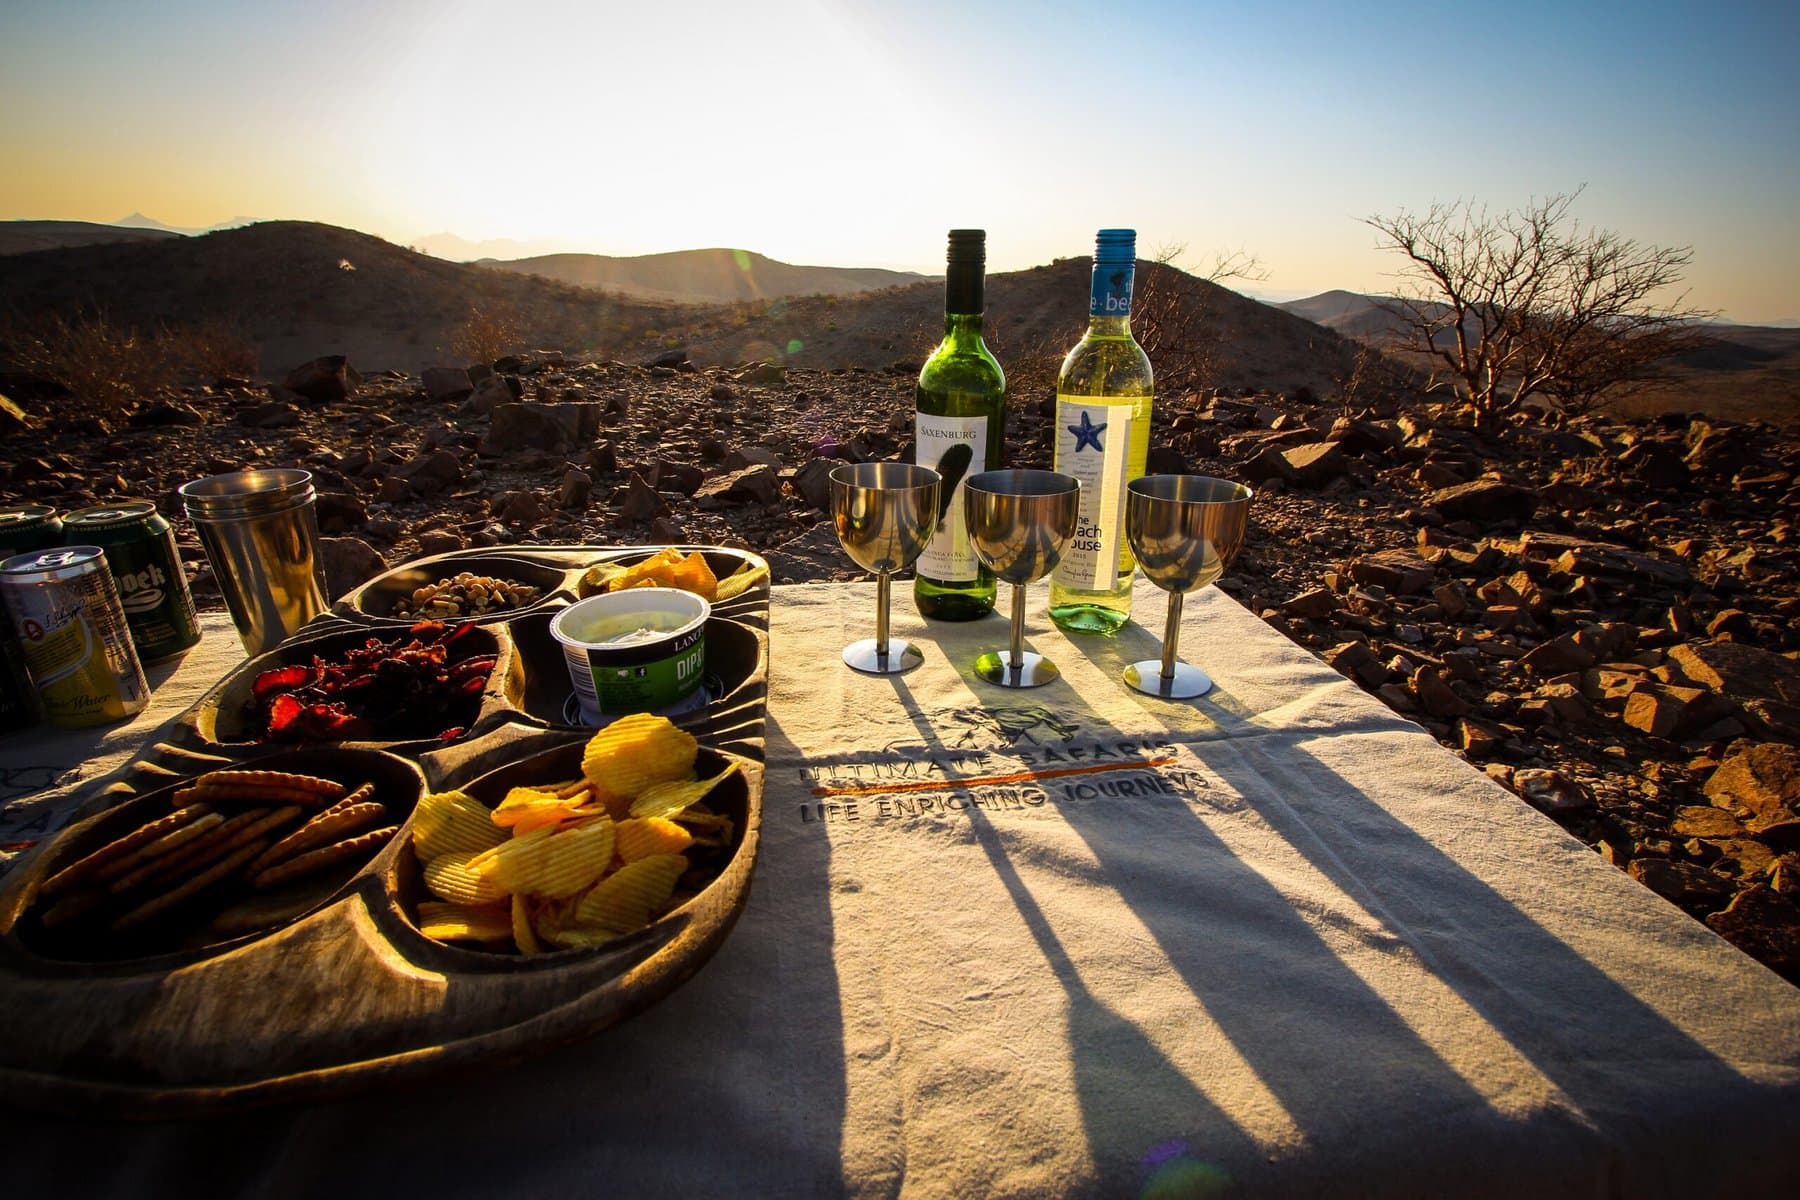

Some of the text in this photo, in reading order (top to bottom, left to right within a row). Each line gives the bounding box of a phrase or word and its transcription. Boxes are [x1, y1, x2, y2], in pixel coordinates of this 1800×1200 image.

[921, 426, 977, 440] SAXENBURG
[1077, 525, 1102, 538] ach
[1071, 539, 1102, 552] ouse
[800, 740, 1178, 782] ULTIMATE SAFARIS
[801, 771, 1209, 823] LIFE ENRICHING JOURNEYS
